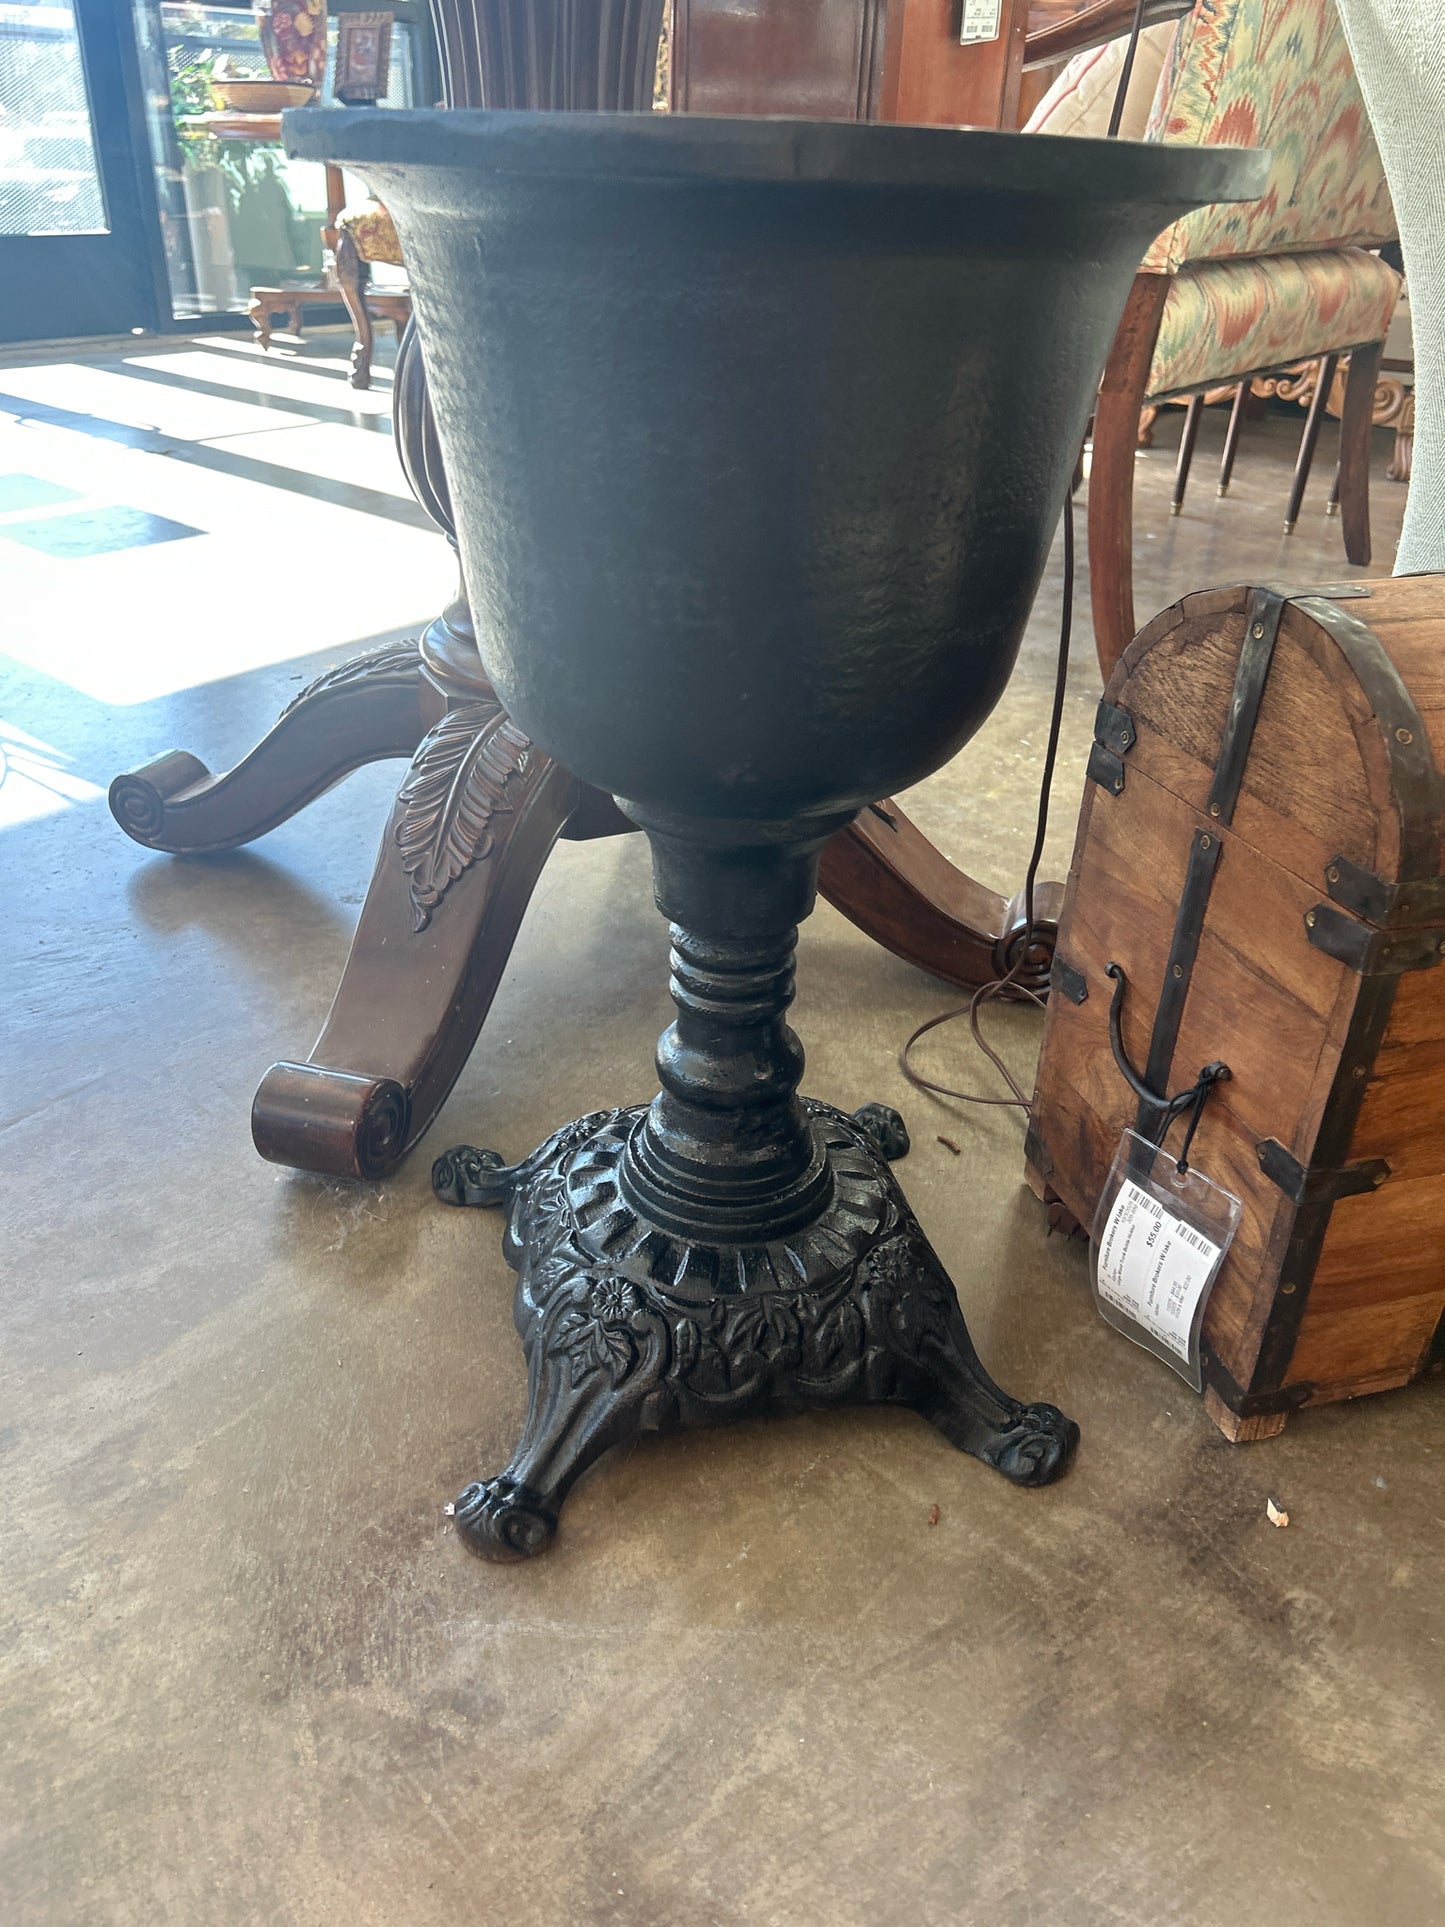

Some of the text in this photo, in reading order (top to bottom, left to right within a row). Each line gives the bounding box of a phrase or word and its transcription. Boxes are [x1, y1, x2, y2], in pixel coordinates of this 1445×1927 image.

[1106, 1225, 1118, 1248] Brokers
[1146, 1221, 1162, 1248] $55.00
[1102, 1247, 1111, 1271] Furniture
[1151, 1261, 1164, 1284] Brokers
[1147, 1283, 1157, 1307] Furniture
